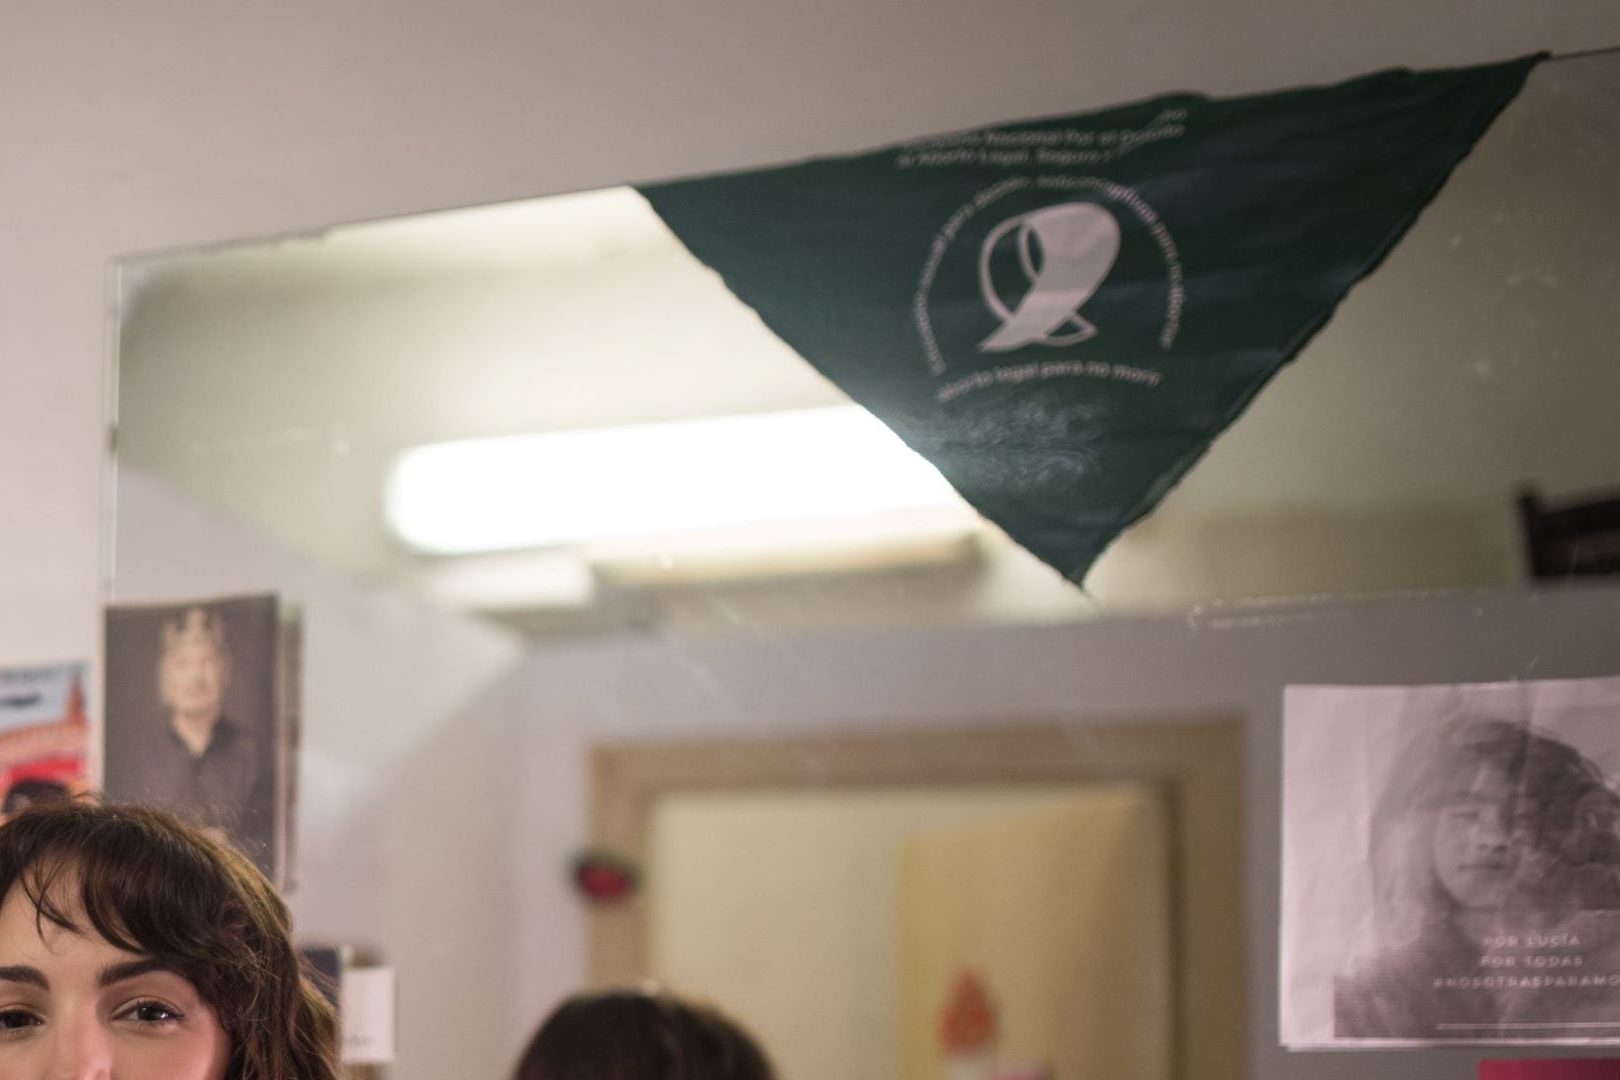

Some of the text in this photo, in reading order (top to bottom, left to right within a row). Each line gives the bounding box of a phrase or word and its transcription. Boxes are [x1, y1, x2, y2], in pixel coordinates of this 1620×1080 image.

[1039, 359, 1084, 380] para
[1085, 360, 1111, 377] no
[1483, 932, 1580, 949] POR LUCÍA
[1480, 954, 1584, 968] POR TODAS
